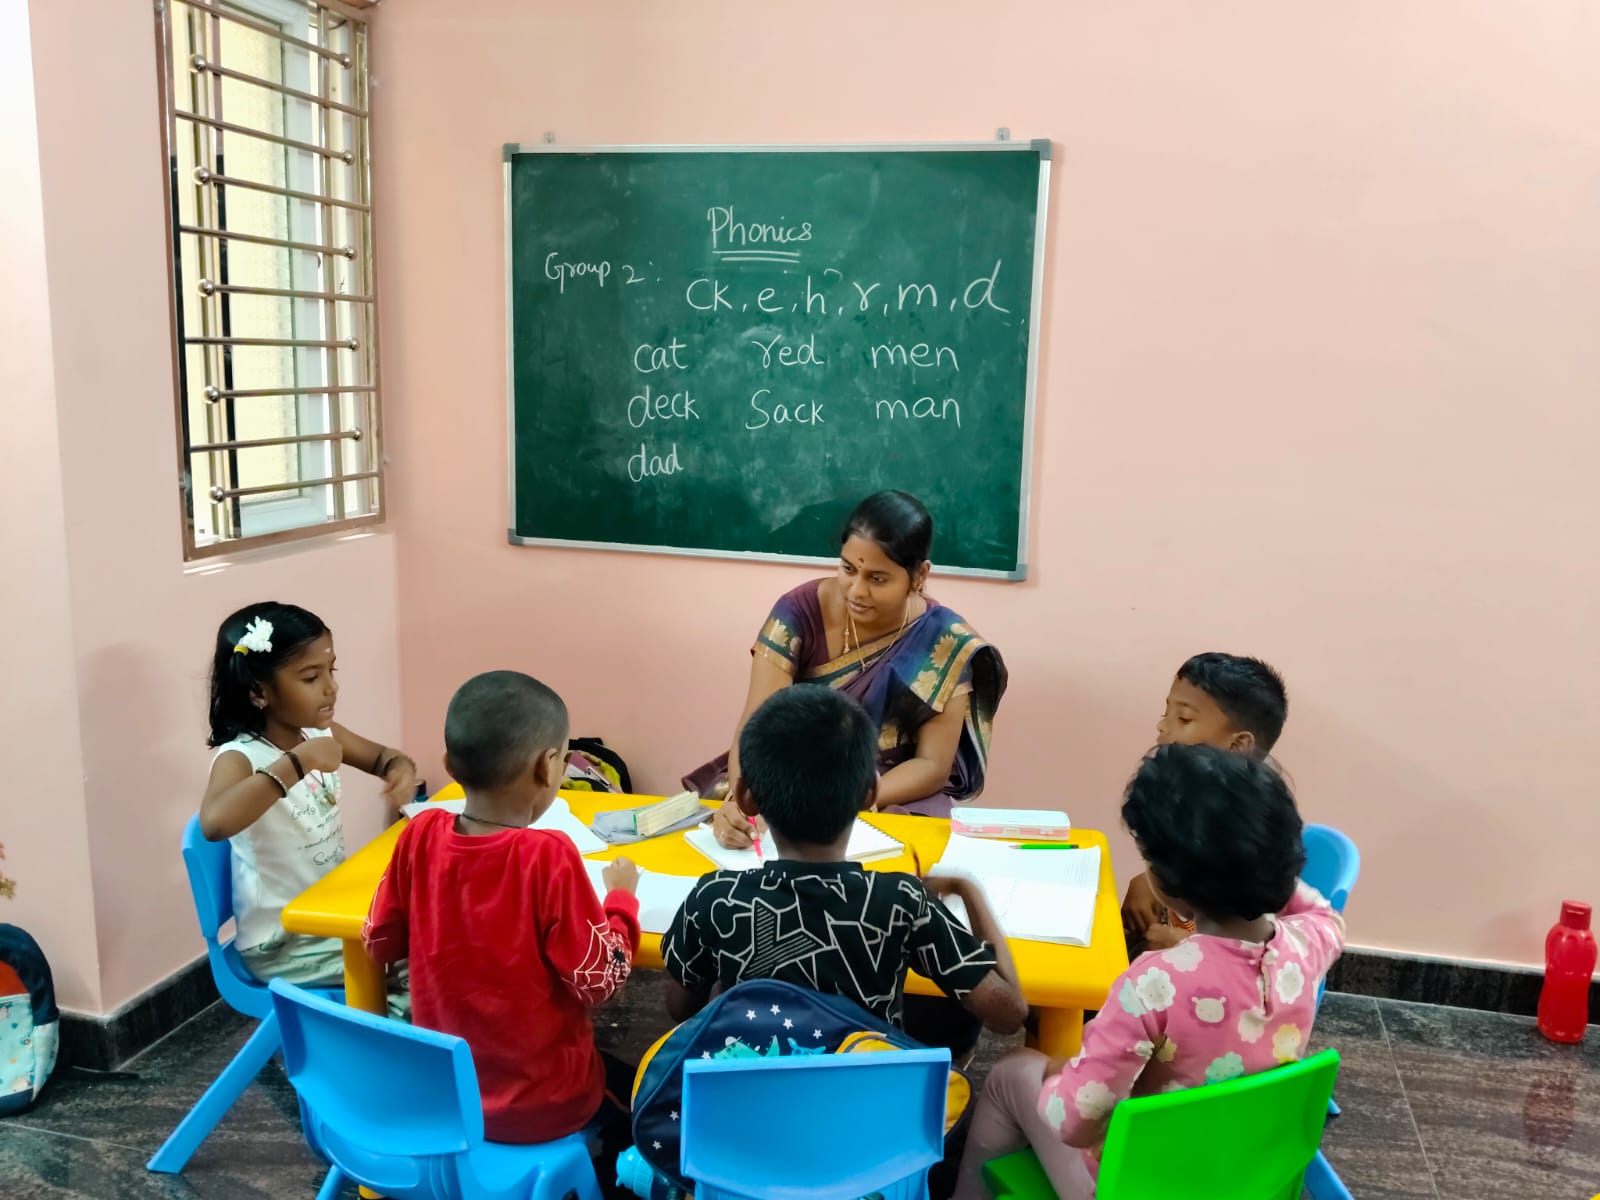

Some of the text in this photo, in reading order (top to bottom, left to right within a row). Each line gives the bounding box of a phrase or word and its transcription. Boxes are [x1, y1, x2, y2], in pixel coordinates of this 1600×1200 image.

[706, 205, 813, 249] Phonics
[544, 251, 611, 294] Group
[633, 332, 960, 374] cat red men
[627, 384, 961, 430] deck Sack man
[627, 442, 685, 484] dad
